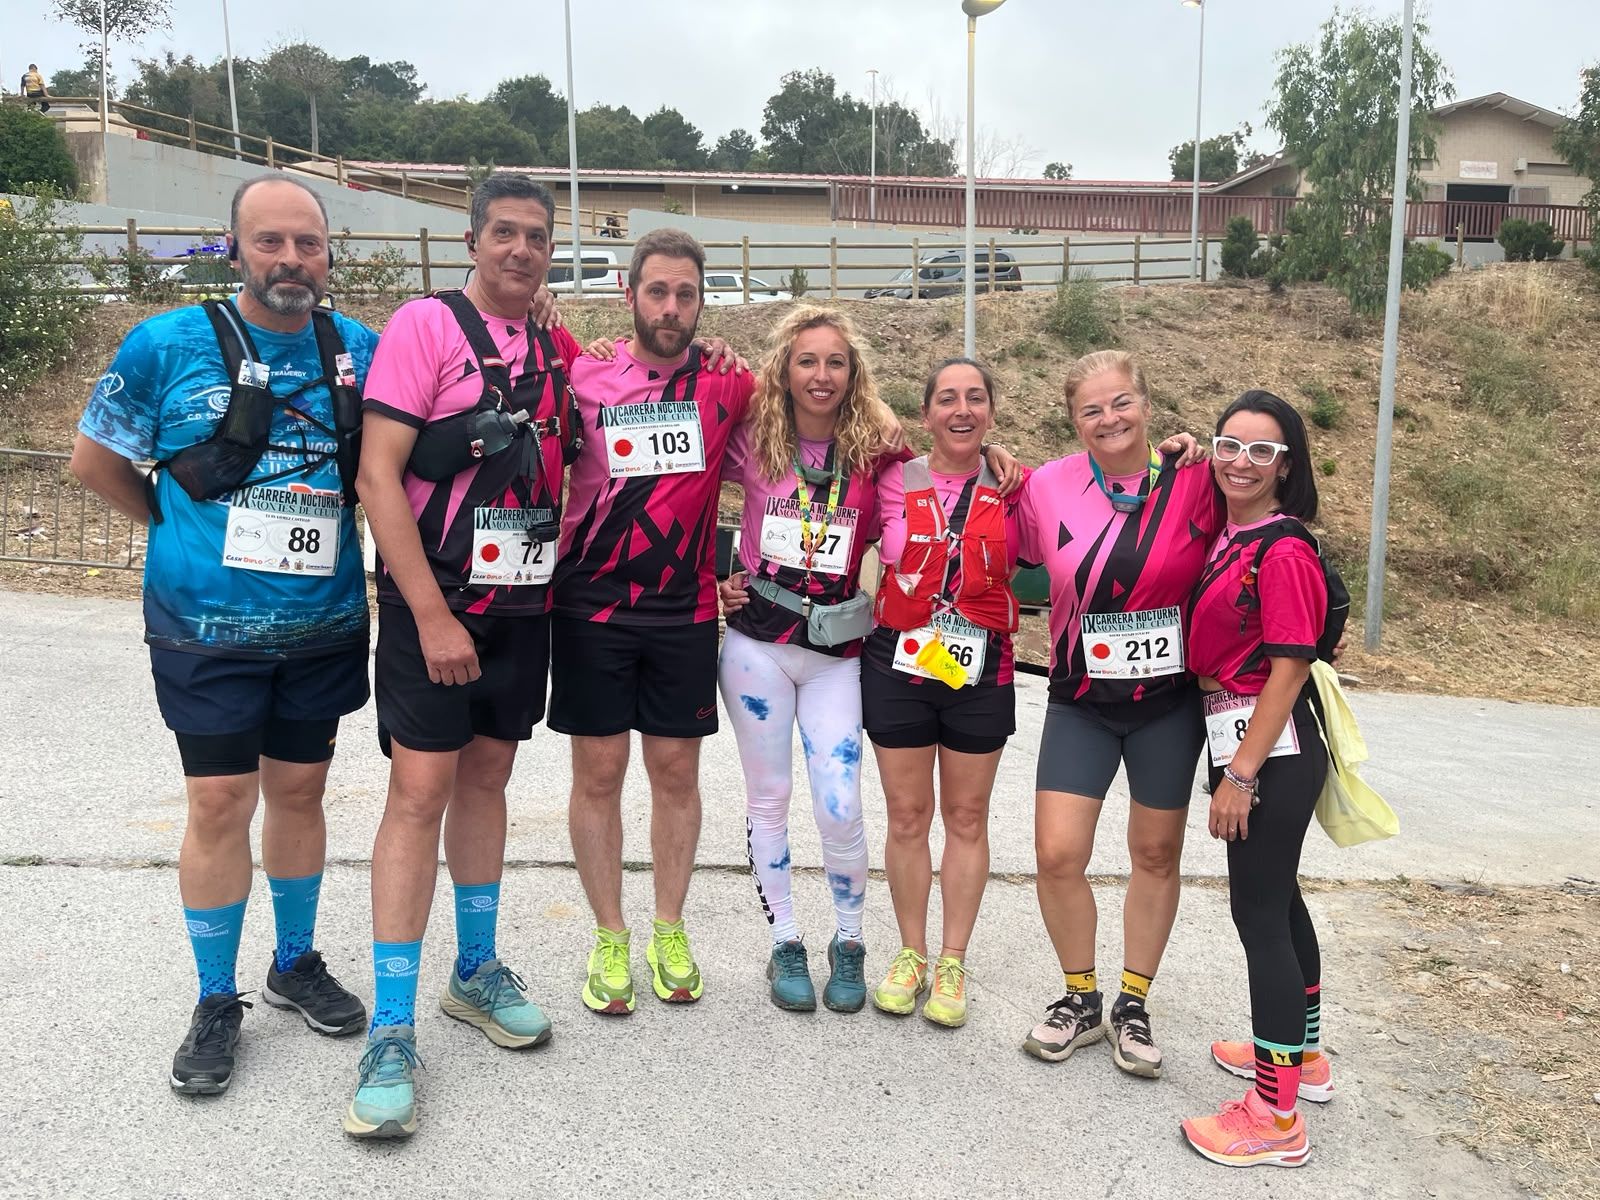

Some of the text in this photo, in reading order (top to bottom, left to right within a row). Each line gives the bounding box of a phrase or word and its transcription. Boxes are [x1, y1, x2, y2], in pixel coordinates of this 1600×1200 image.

[604, 402, 697, 427] IX CARRERA NOCTURNA
[618, 414, 656, 426] MONTES
[658, 414, 669, 422] DE
[672, 412, 698, 420] CEUTA
[648, 431, 691, 456] 103
[232, 486, 340, 510] IX CARRERA NOCTURNA
[250, 500, 340, 518] MONTES DE CEUTA
[766, 497, 856, 520] IX CARRA NOTURNA
[476, 508, 553, 530] IX CARRERA NOCTURN
[492, 520, 524, 530] MONTES
[288, 527, 321, 554] 88
[226, 554, 242, 562] CASH
[521, 542, 543, 564] 72
[1082, 608, 1179, 634] IX CARRERA NOCTURNA
[1096, 618, 1180, 632] MONTES DE CEUTA
[964, 628, 986, 638] CEUTA
[1125, 636, 1170, 661] 212
[1212, 700, 1238, 713] MONTES
